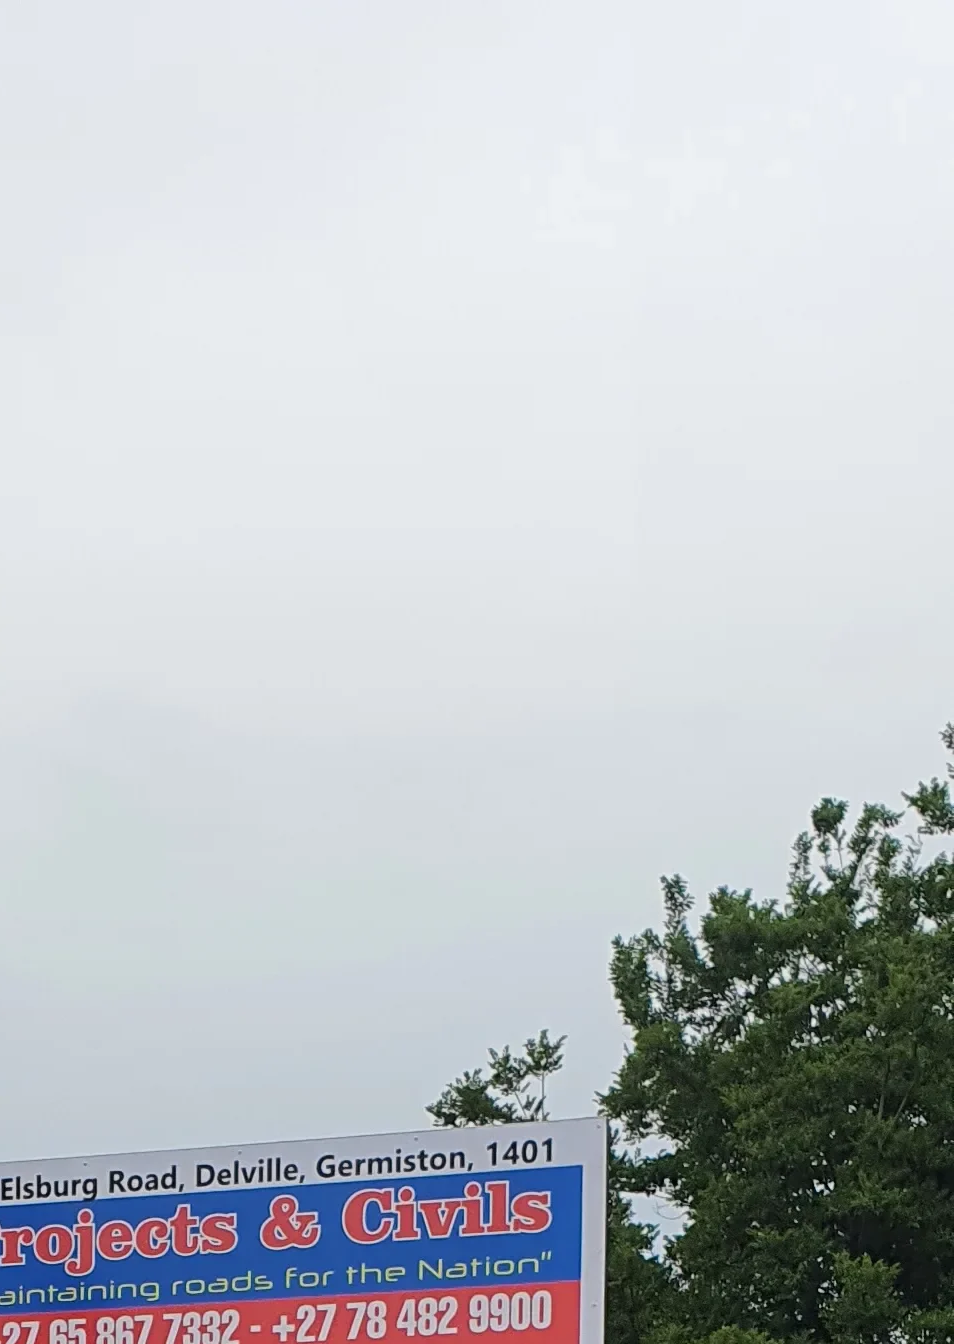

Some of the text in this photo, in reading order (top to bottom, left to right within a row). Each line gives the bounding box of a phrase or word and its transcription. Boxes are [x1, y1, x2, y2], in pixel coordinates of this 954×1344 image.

[0, 1176, 98, 1201] Elsburg
[108, 1165, 186, 1193] Road,
[196, 1157, 306, 1187] Delville,
[316, 1149, 474, 1178] Germiston,
[486, 1138, 554, 1166] 1401
[259, 1194, 321, 1250] &
[342, 1181, 553, 1244] Civils
[172, 1270, 273, 1295] roads
[285, 1268, 334, 1289] for
[346, 1263, 406, 1284] the
[418, 1250, 552, 1280] Nation"
[250, 1324, 261, 1333] -
[272, 1303, 336, 1342] +27
[346, 1300, 387, 1340] 78
[397, 1295, 458, 1337] 482
[469, 1290, 552, 1333] 9900
